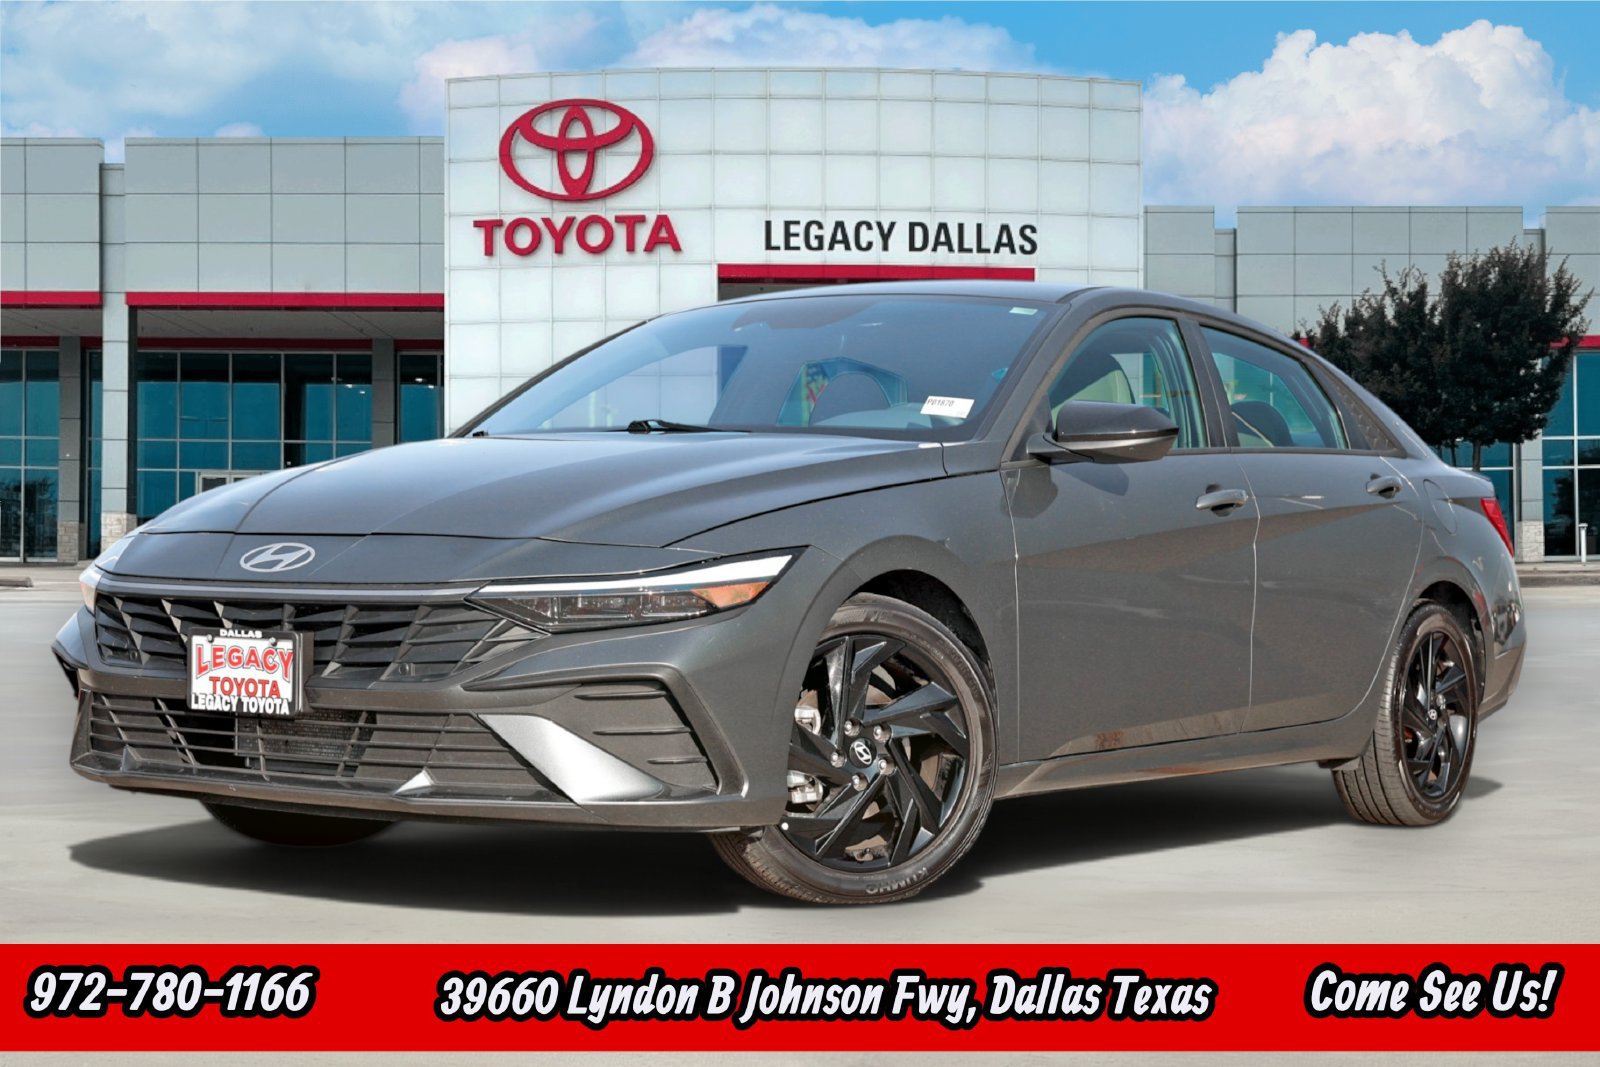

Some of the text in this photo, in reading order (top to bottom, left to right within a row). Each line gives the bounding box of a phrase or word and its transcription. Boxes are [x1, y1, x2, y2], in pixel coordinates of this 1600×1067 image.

[474, 214, 682, 257] TOYOTA
[765, 220, 1039, 256] LEGACY DALLAS
[219, 629, 262, 638] DALLAS
[196, 644, 294, 683] LEGACY
[209, 676, 281, 698] TOYOTA
[191, 693, 290, 715] LEGACY TOYOTA
